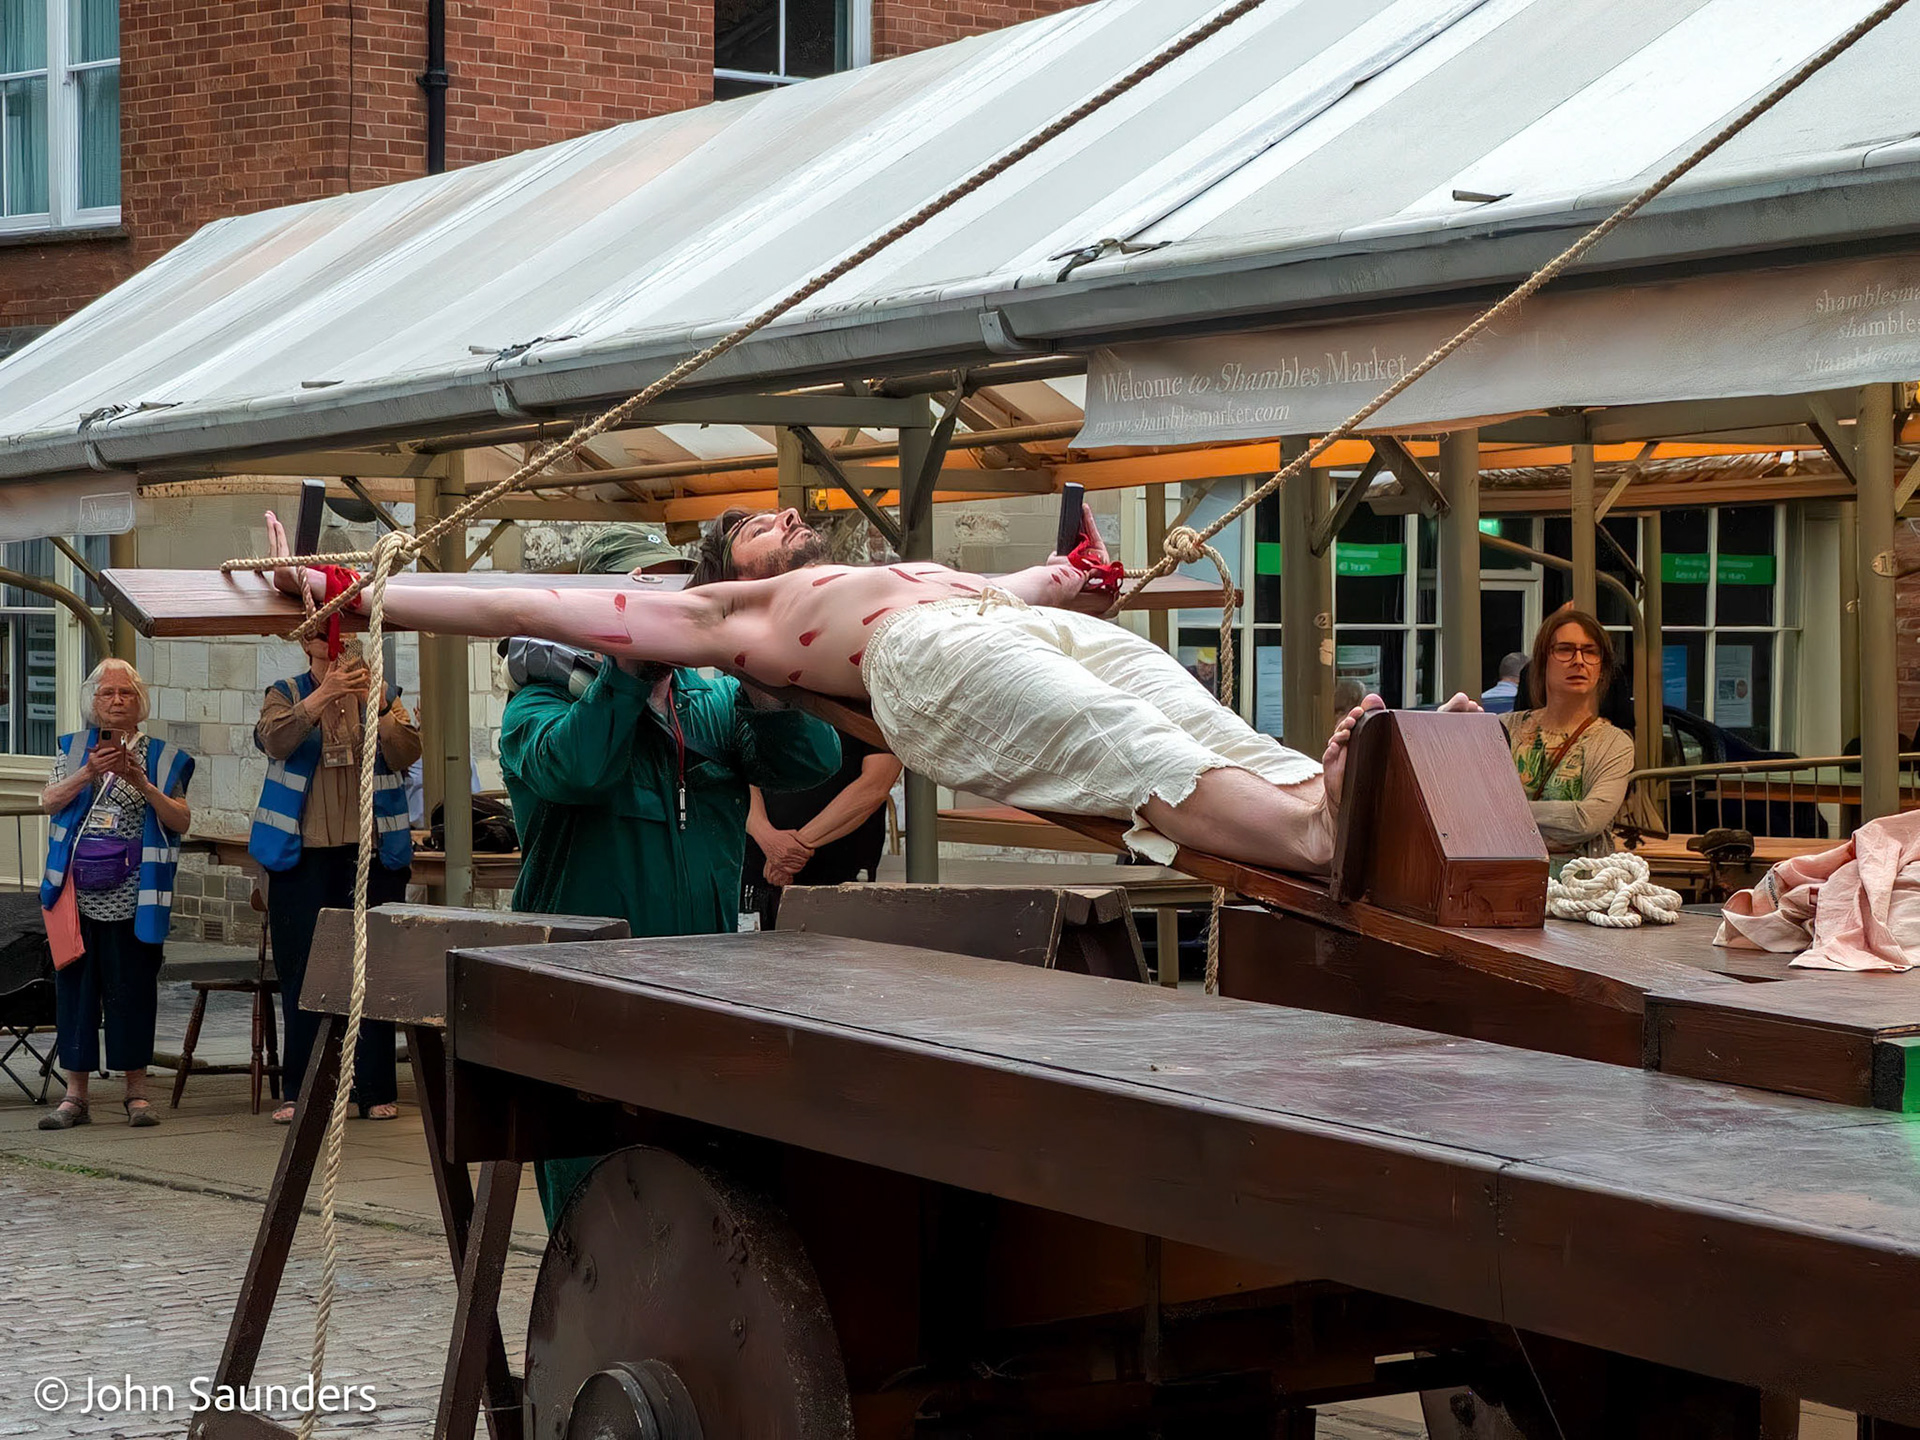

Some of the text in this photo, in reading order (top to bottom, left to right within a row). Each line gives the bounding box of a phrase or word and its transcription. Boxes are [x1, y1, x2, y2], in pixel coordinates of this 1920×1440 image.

[1102, 345, 1407, 404] Welcome to Shambles Market
